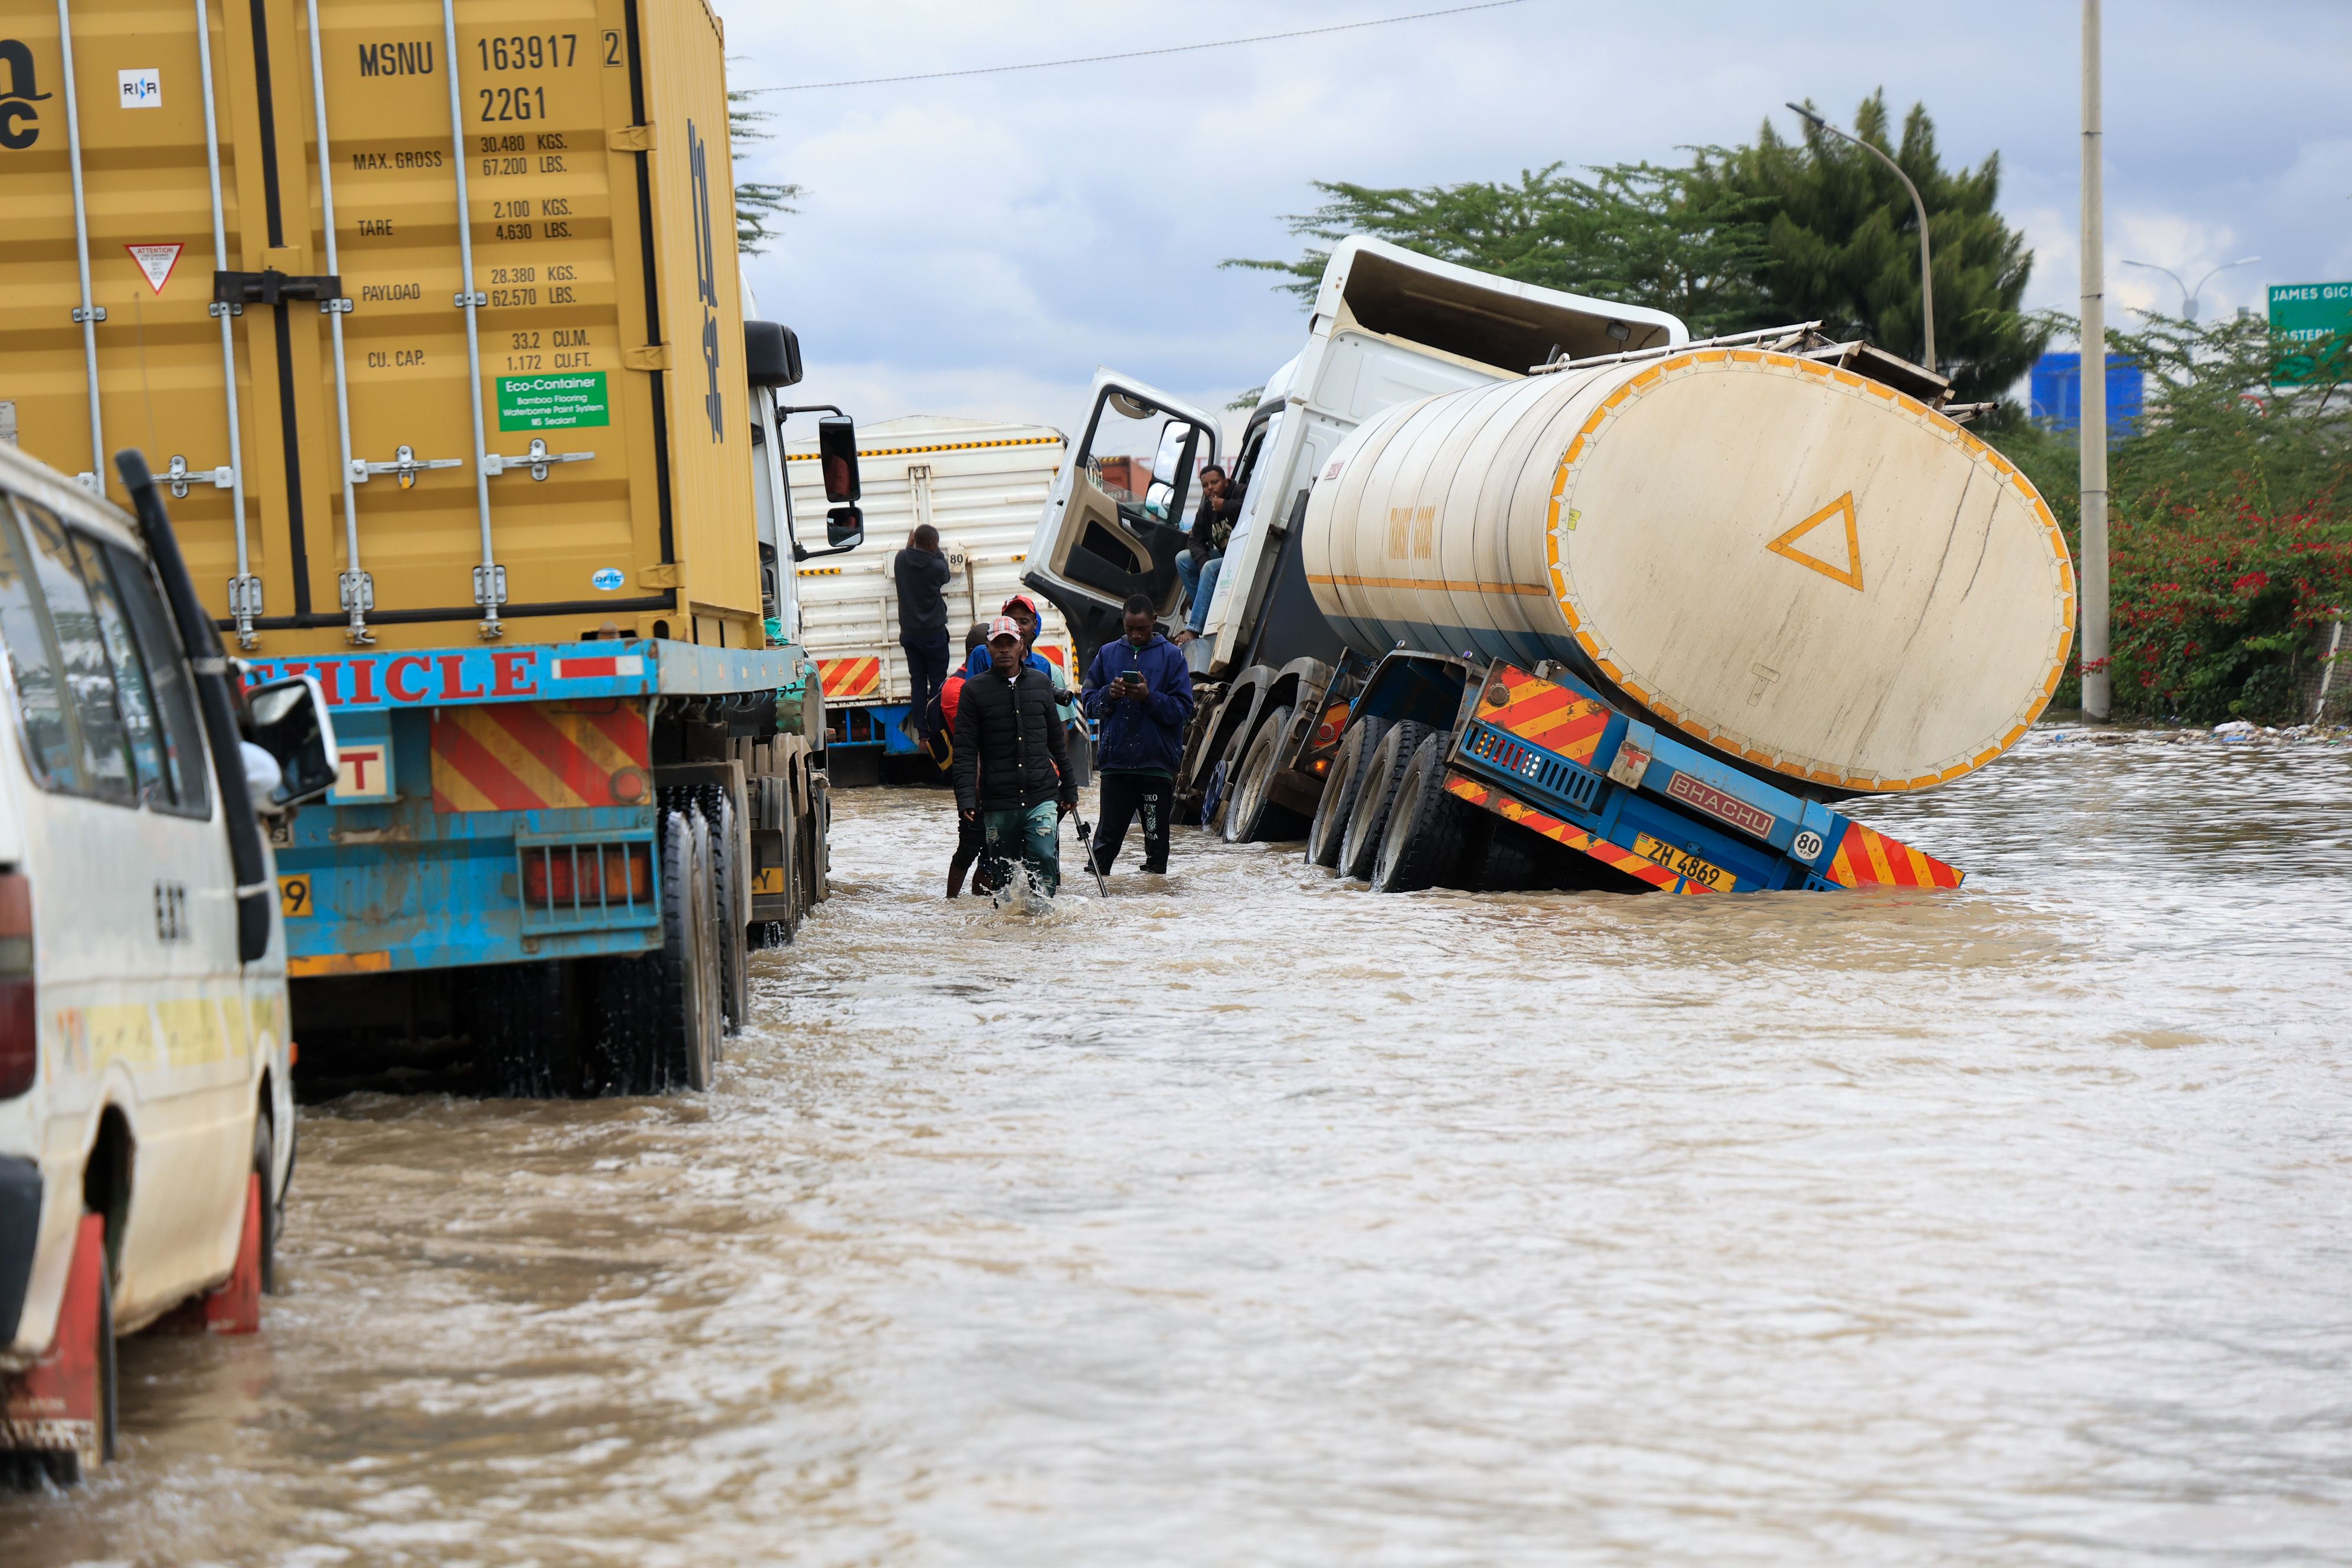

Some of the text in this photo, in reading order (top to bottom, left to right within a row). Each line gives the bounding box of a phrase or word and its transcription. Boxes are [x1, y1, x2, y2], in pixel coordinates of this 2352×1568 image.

[359, 32, 621, 77] MSNU 163917 2
[480, 87, 545, 122] 22G1
[481, 133, 567, 153] 30.480 KGS.
[354, 151, 442, 171] MAX. GROSS
[483, 156, 567, 176] 67.200 LBS.
[494, 199, 572, 218] 2.100 KGS.
[358, 219, 393, 237] TARE
[496, 222, 572, 240] 4.630 LBS.
[491, 265, 577, 284] 28.380 KGS.
[362, 284, 421, 302] PAYLOAD
[492, 287, 576, 307] 62.570 LBS.
[2272, 288, 2318, 302] JAMES
[512, 329, 590, 349] 33.2 CU.M.
[368, 351, 425, 368] CU. CAP.
[507, 352, 592, 371] 1.172 CU.FT.
[505, 377, 596, 393] Eco-Container
[517, 393, 589, 405] Bamboo Flooring
[503, 403, 605, 417] Waterborne Paint System
[545, 415, 577, 425] Sealant
[1414, 505, 1436, 560] GOODS
[950, 554, 963, 563] 80
[1623, 749, 1647, 768] T
[339, 752, 378, 790] T
[1142, 793, 1158, 802] UKO
[1674, 778, 1770, 831] BHACHU
[1797, 834, 1820, 854] 80
[1648, 841, 1720, 886] ZH 4869
